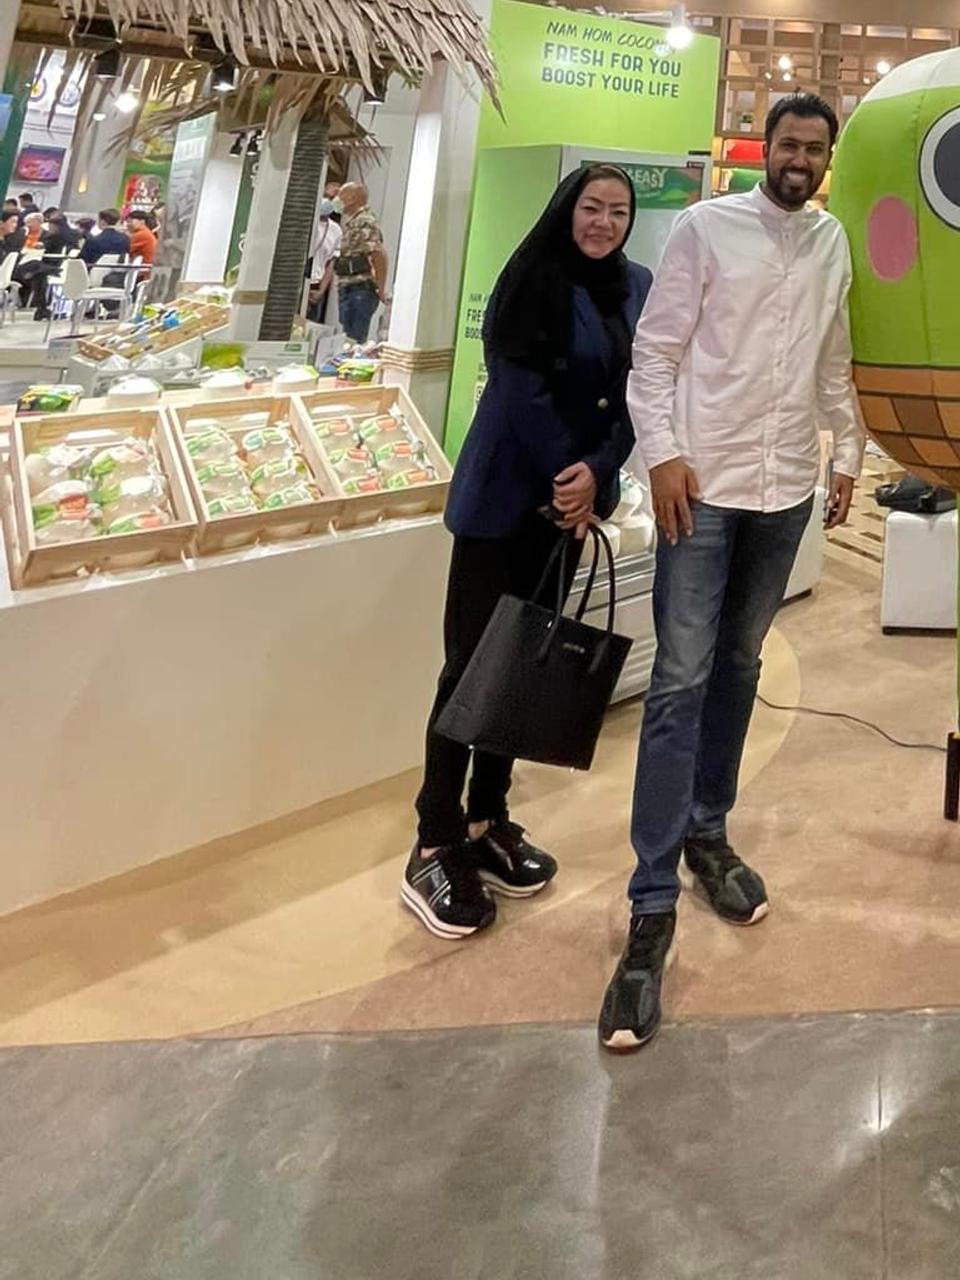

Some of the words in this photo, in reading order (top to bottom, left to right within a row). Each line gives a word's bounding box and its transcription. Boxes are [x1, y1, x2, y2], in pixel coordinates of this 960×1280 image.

[546, 22, 577, 37] NAM
[582, 27, 612, 43] HOM
[617, 33, 677, 55] COCO
[543, 42, 604, 67] FRESH
[610, 52, 643, 73] FOR
[650, 59, 682, 78] YOU
[541, 67, 597, 88] BOOST
[601, 75, 644, 95] YOUR
[647, 82, 680, 99] LIFE
